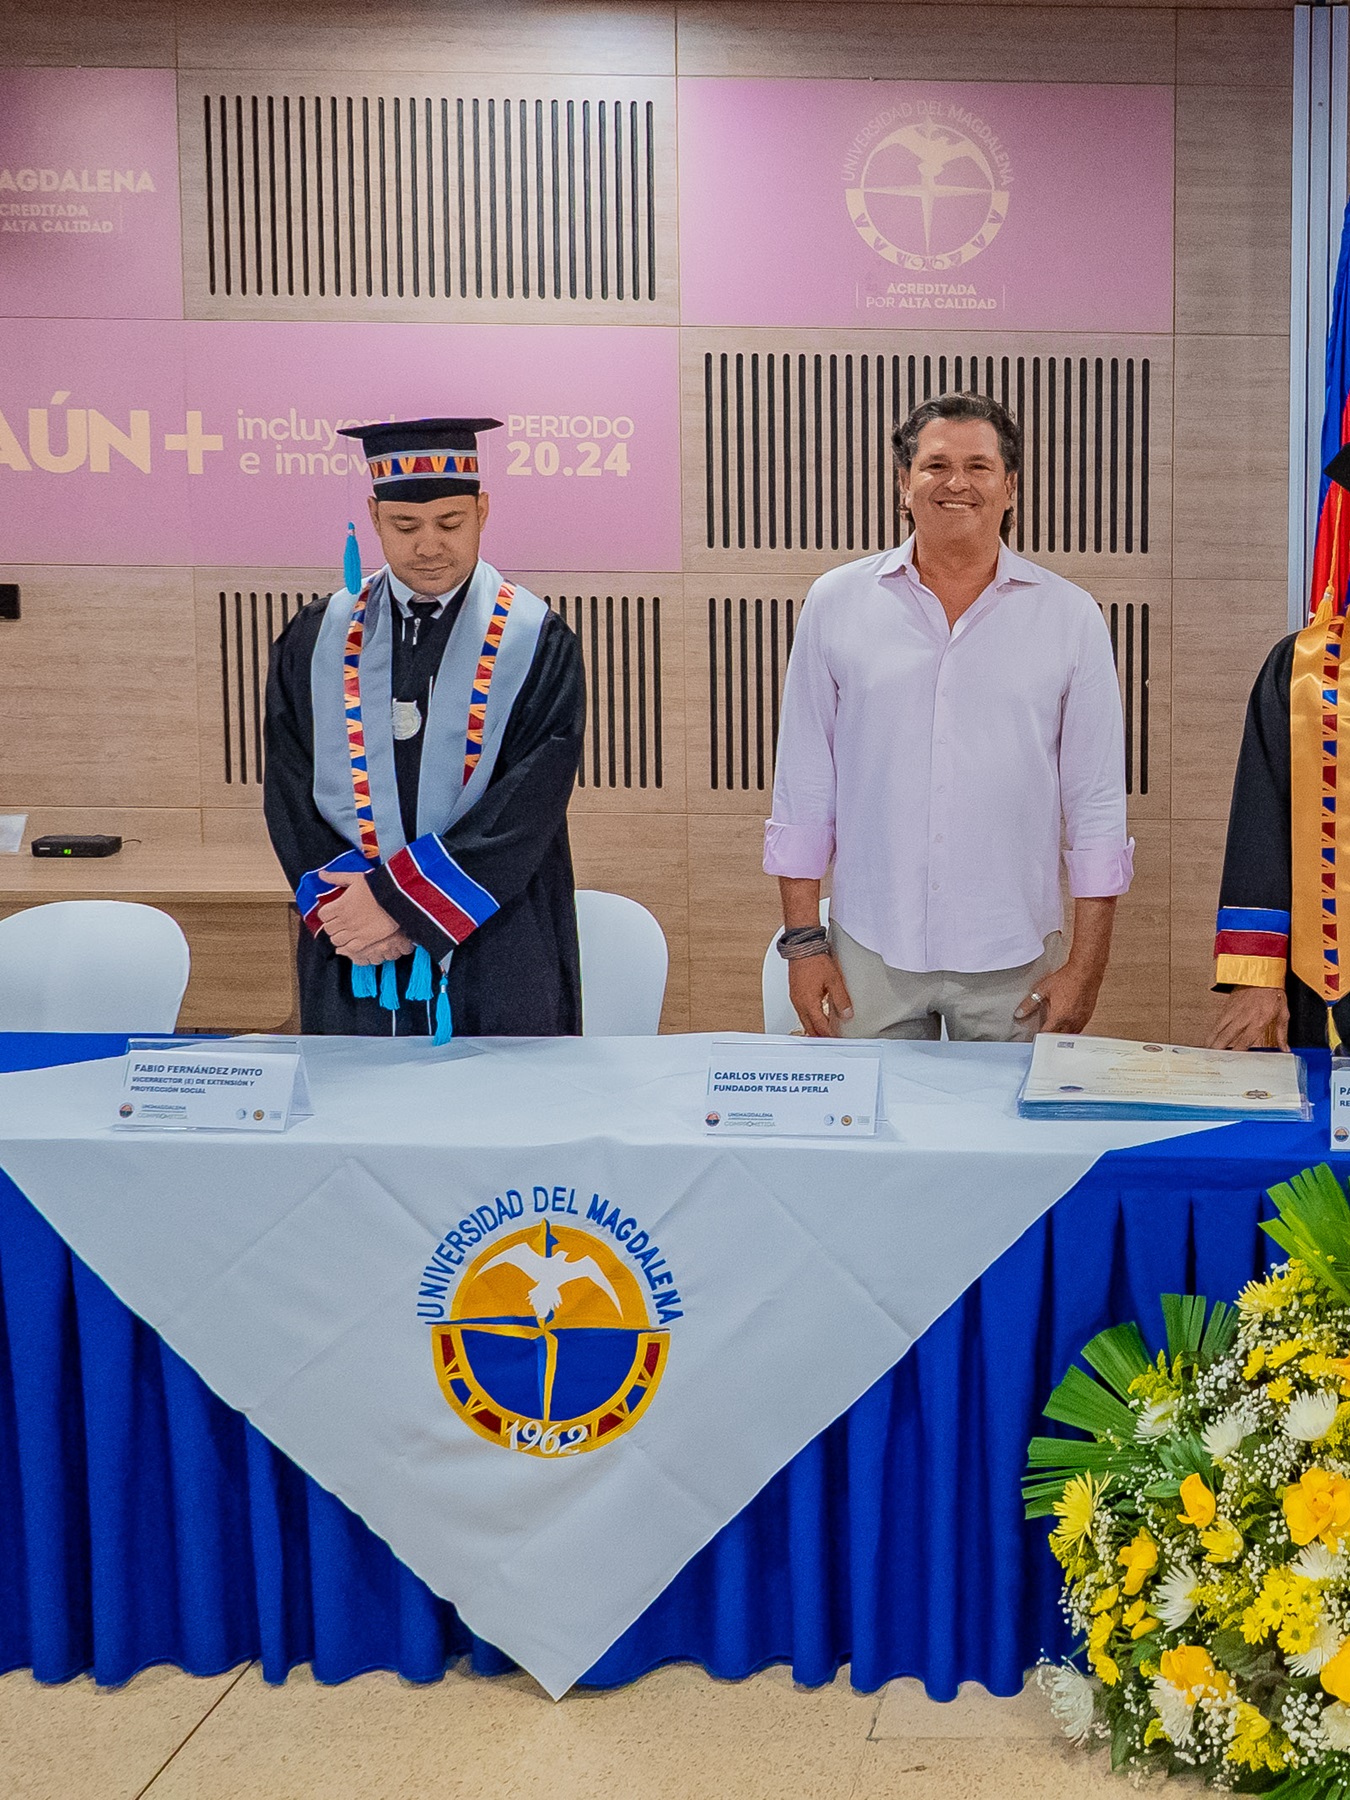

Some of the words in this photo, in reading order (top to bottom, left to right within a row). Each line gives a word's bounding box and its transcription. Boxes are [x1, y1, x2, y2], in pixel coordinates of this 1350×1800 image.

[840, 102, 913, 182] UNIVERSIDAD
[949, 105, 1015, 187] MAGDALENA
[0, 168, 157, 193] AGDALENA
[0, 204, 89, 217] CREDITADA
[42, 220, 114, 233] CALIDAD
[887, 283, 976, 296] ACREDITADA
[866, 297, 895, 308] POR
[899, 297, 932, 309] ALTA
[934, 298, 997, 310] CALIDAD
[508, 414, 634, 439] PERIODO
[239, 451, 260, 476] e
[276, 444, 368, 477] innov
[507, 441, 631, 477] 20.24
[134, 1064, 165, 1073] FABIO
[167, 1065, 229, 1075] FERNÁNDEZ
[230, 1067, 263, 1077] PINTO
[714, 1071, 756, 1081] CARLOS
[758, 1072, 789, 1081] VIVES
[791, 1072, 845, 1082] RESTREPO
[132, 1076, 182, 1084] VICERRECTOR
[207, 1078, 248, 1086] EXTENSIÓN
[130, 1085, 178, 1093] PROYECCIÓN
[713, 1084, 763, 1092] FUNDADOR
[765, 1085, 788, 1093] TRAS
[789, 1085, 799, 1093] LA
[417, 1190, 524, 1318] UNIVERSIDAD
[533, 1186, 579, 1215] DEL
[586, 1193, 684, 1325] MAGDALENA
[505, 1419, 588, 1455] 1962
